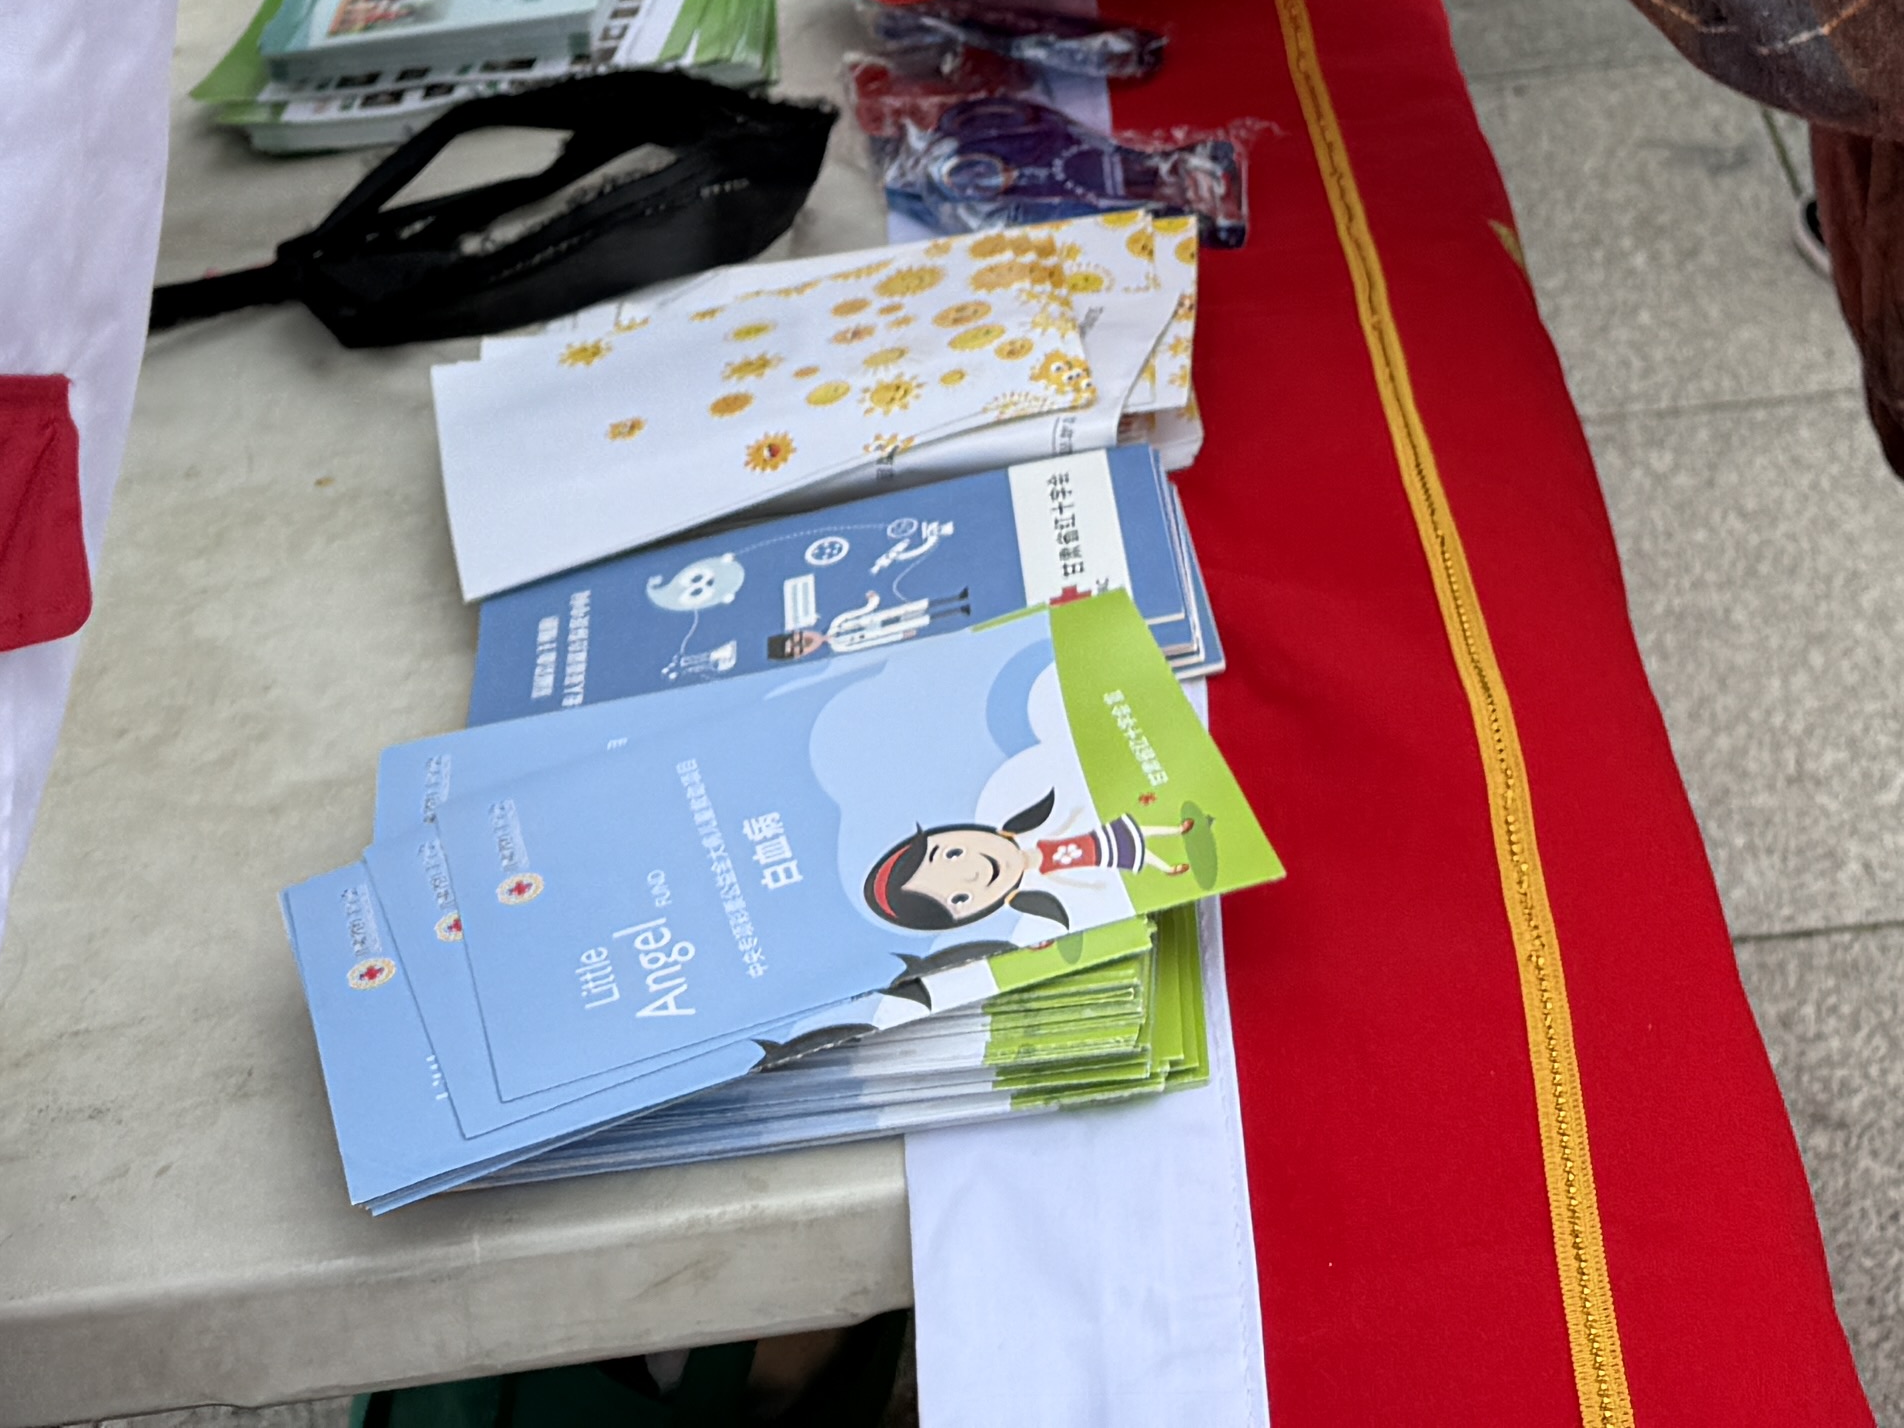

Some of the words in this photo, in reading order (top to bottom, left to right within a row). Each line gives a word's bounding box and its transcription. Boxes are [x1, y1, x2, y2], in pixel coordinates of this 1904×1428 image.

[1047, 472, 1085, 577] 甘肃省红十字会
[647, 868, 671, 908] FUND
[742, 812, 803, 889] 白血病
[575, 945, 620, 1011] Little
[612, 916, 696, 1019] Angel
